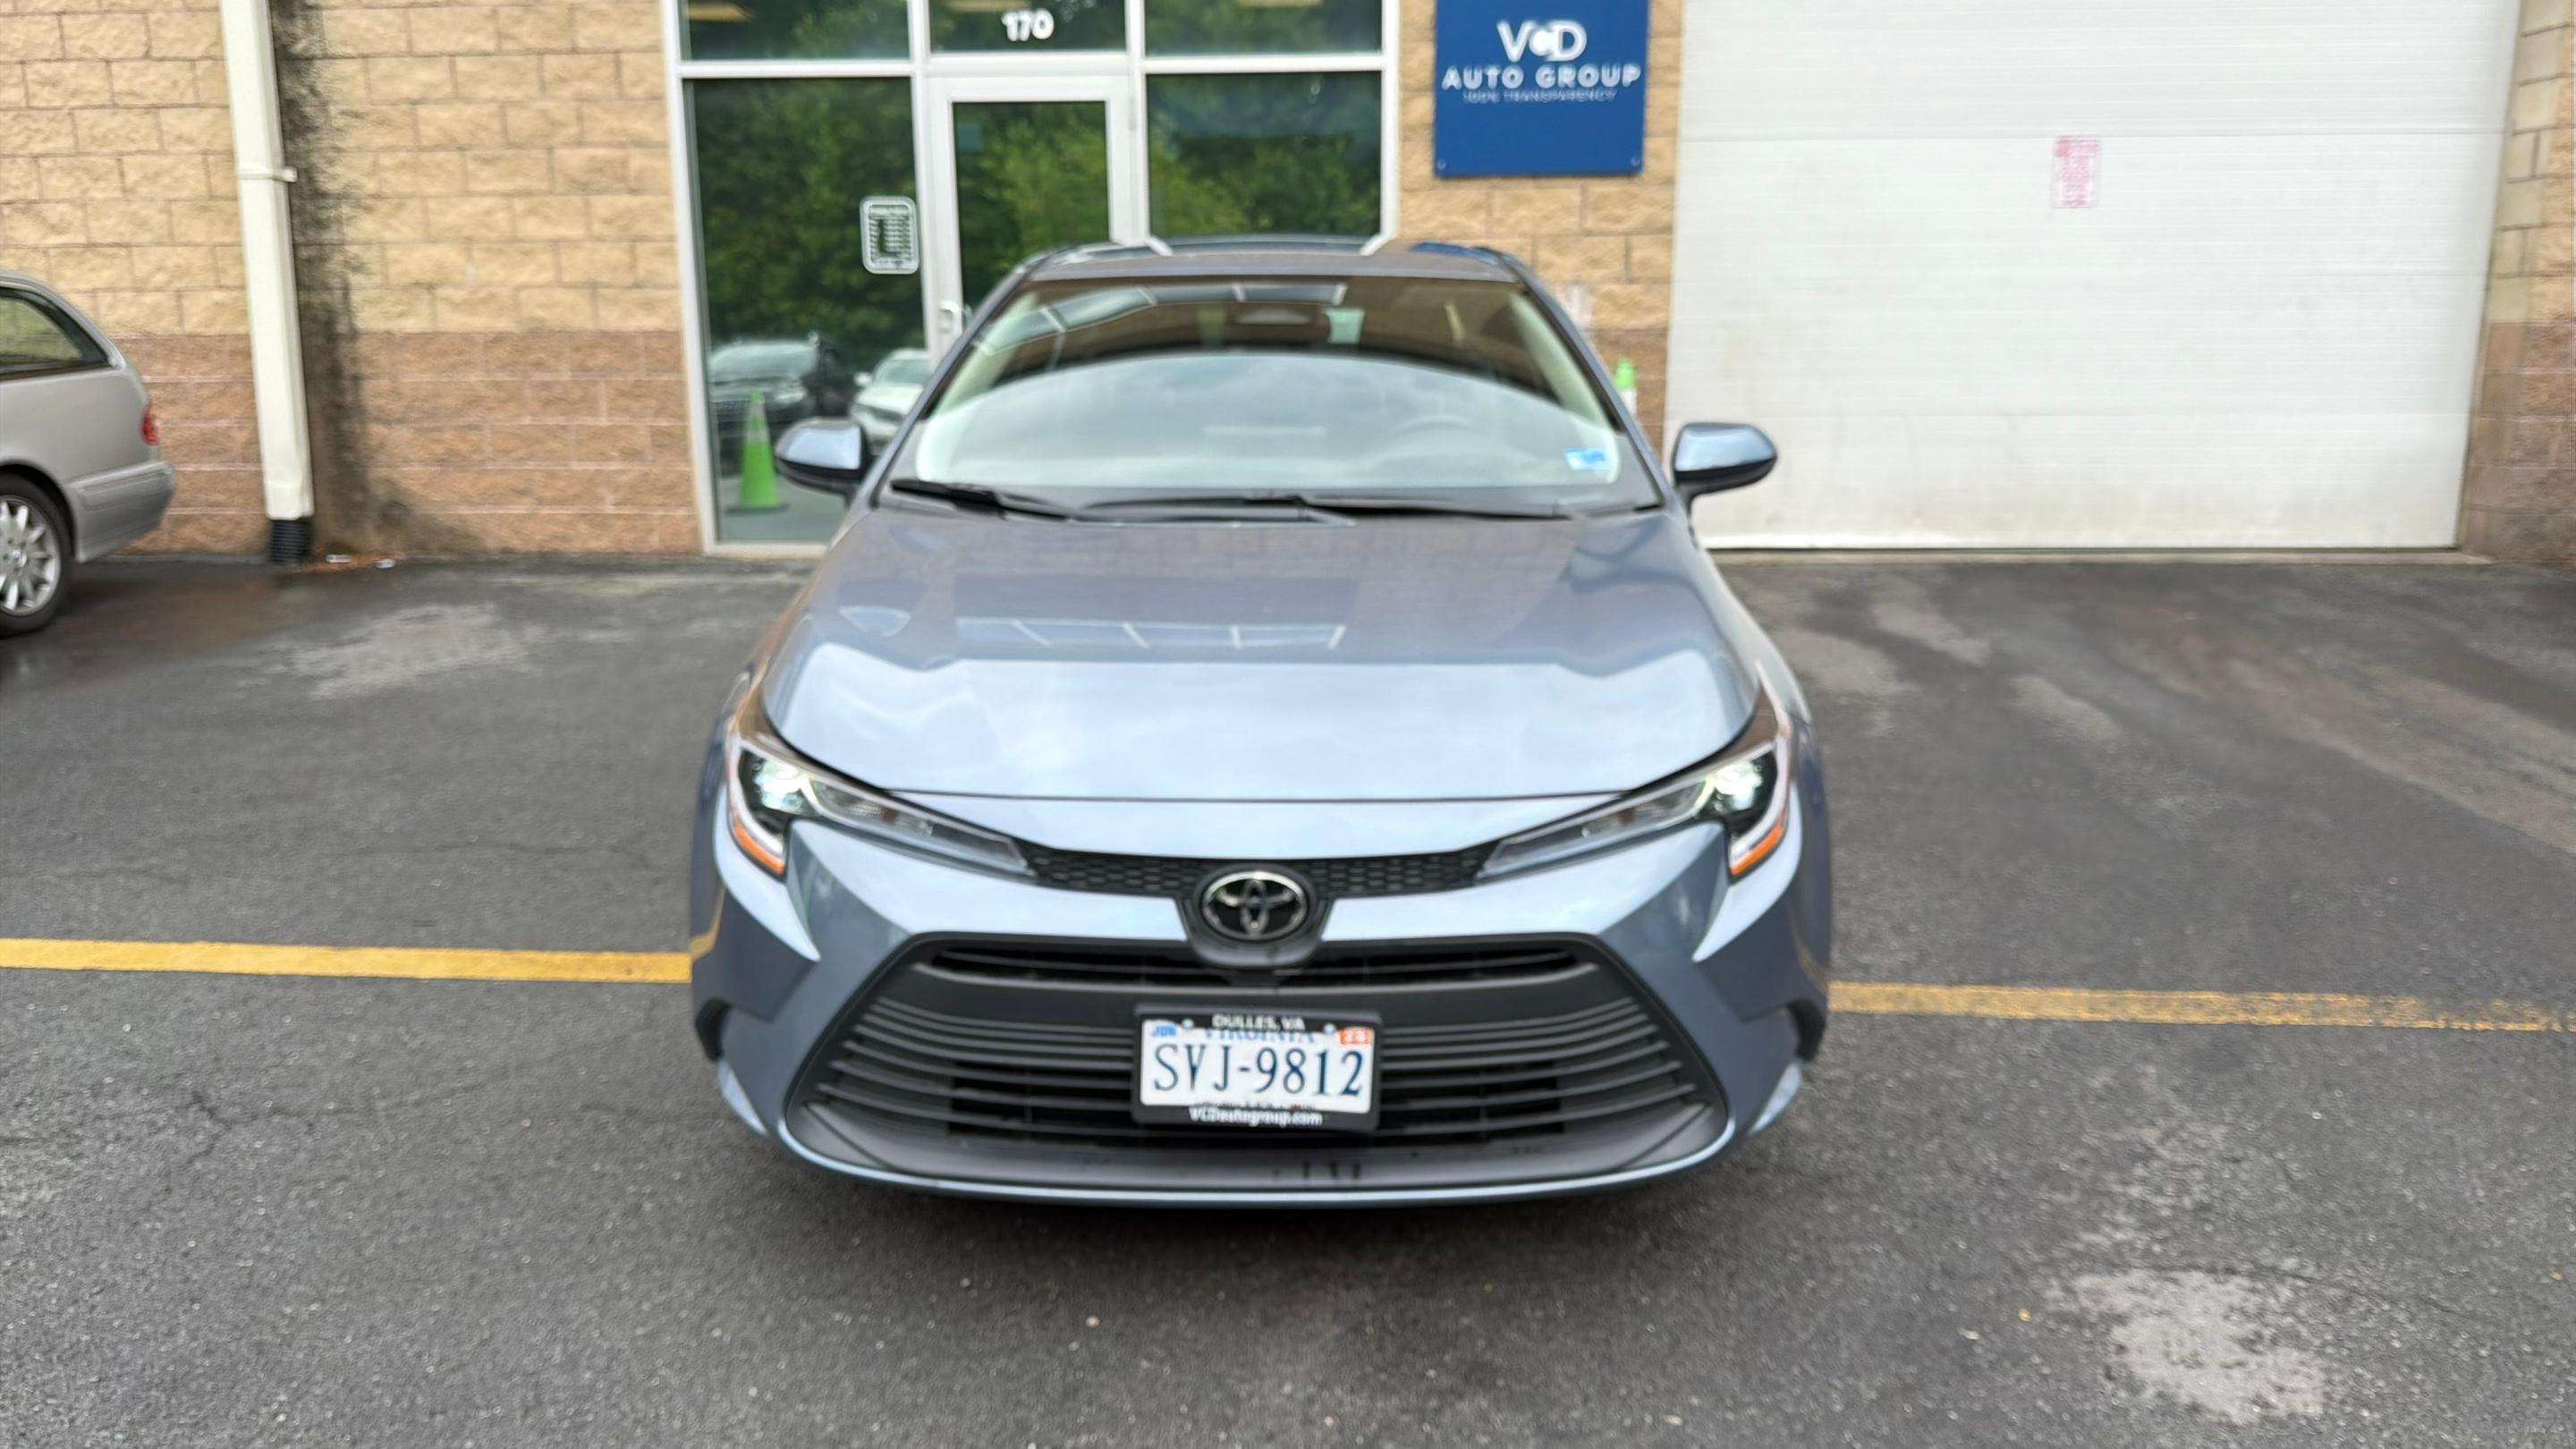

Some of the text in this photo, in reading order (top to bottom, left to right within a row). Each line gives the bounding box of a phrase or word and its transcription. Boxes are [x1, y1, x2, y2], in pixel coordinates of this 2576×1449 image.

[1002, 8, 1054, 42] 170
[1496, 20, 1588, 63] VCD
[1442, 64, 1641, 90] AUTO GROUP
[1280, 1015, 1306, 1030] VA
[1153, 1042, 1364, 1097] SVJ-9812
